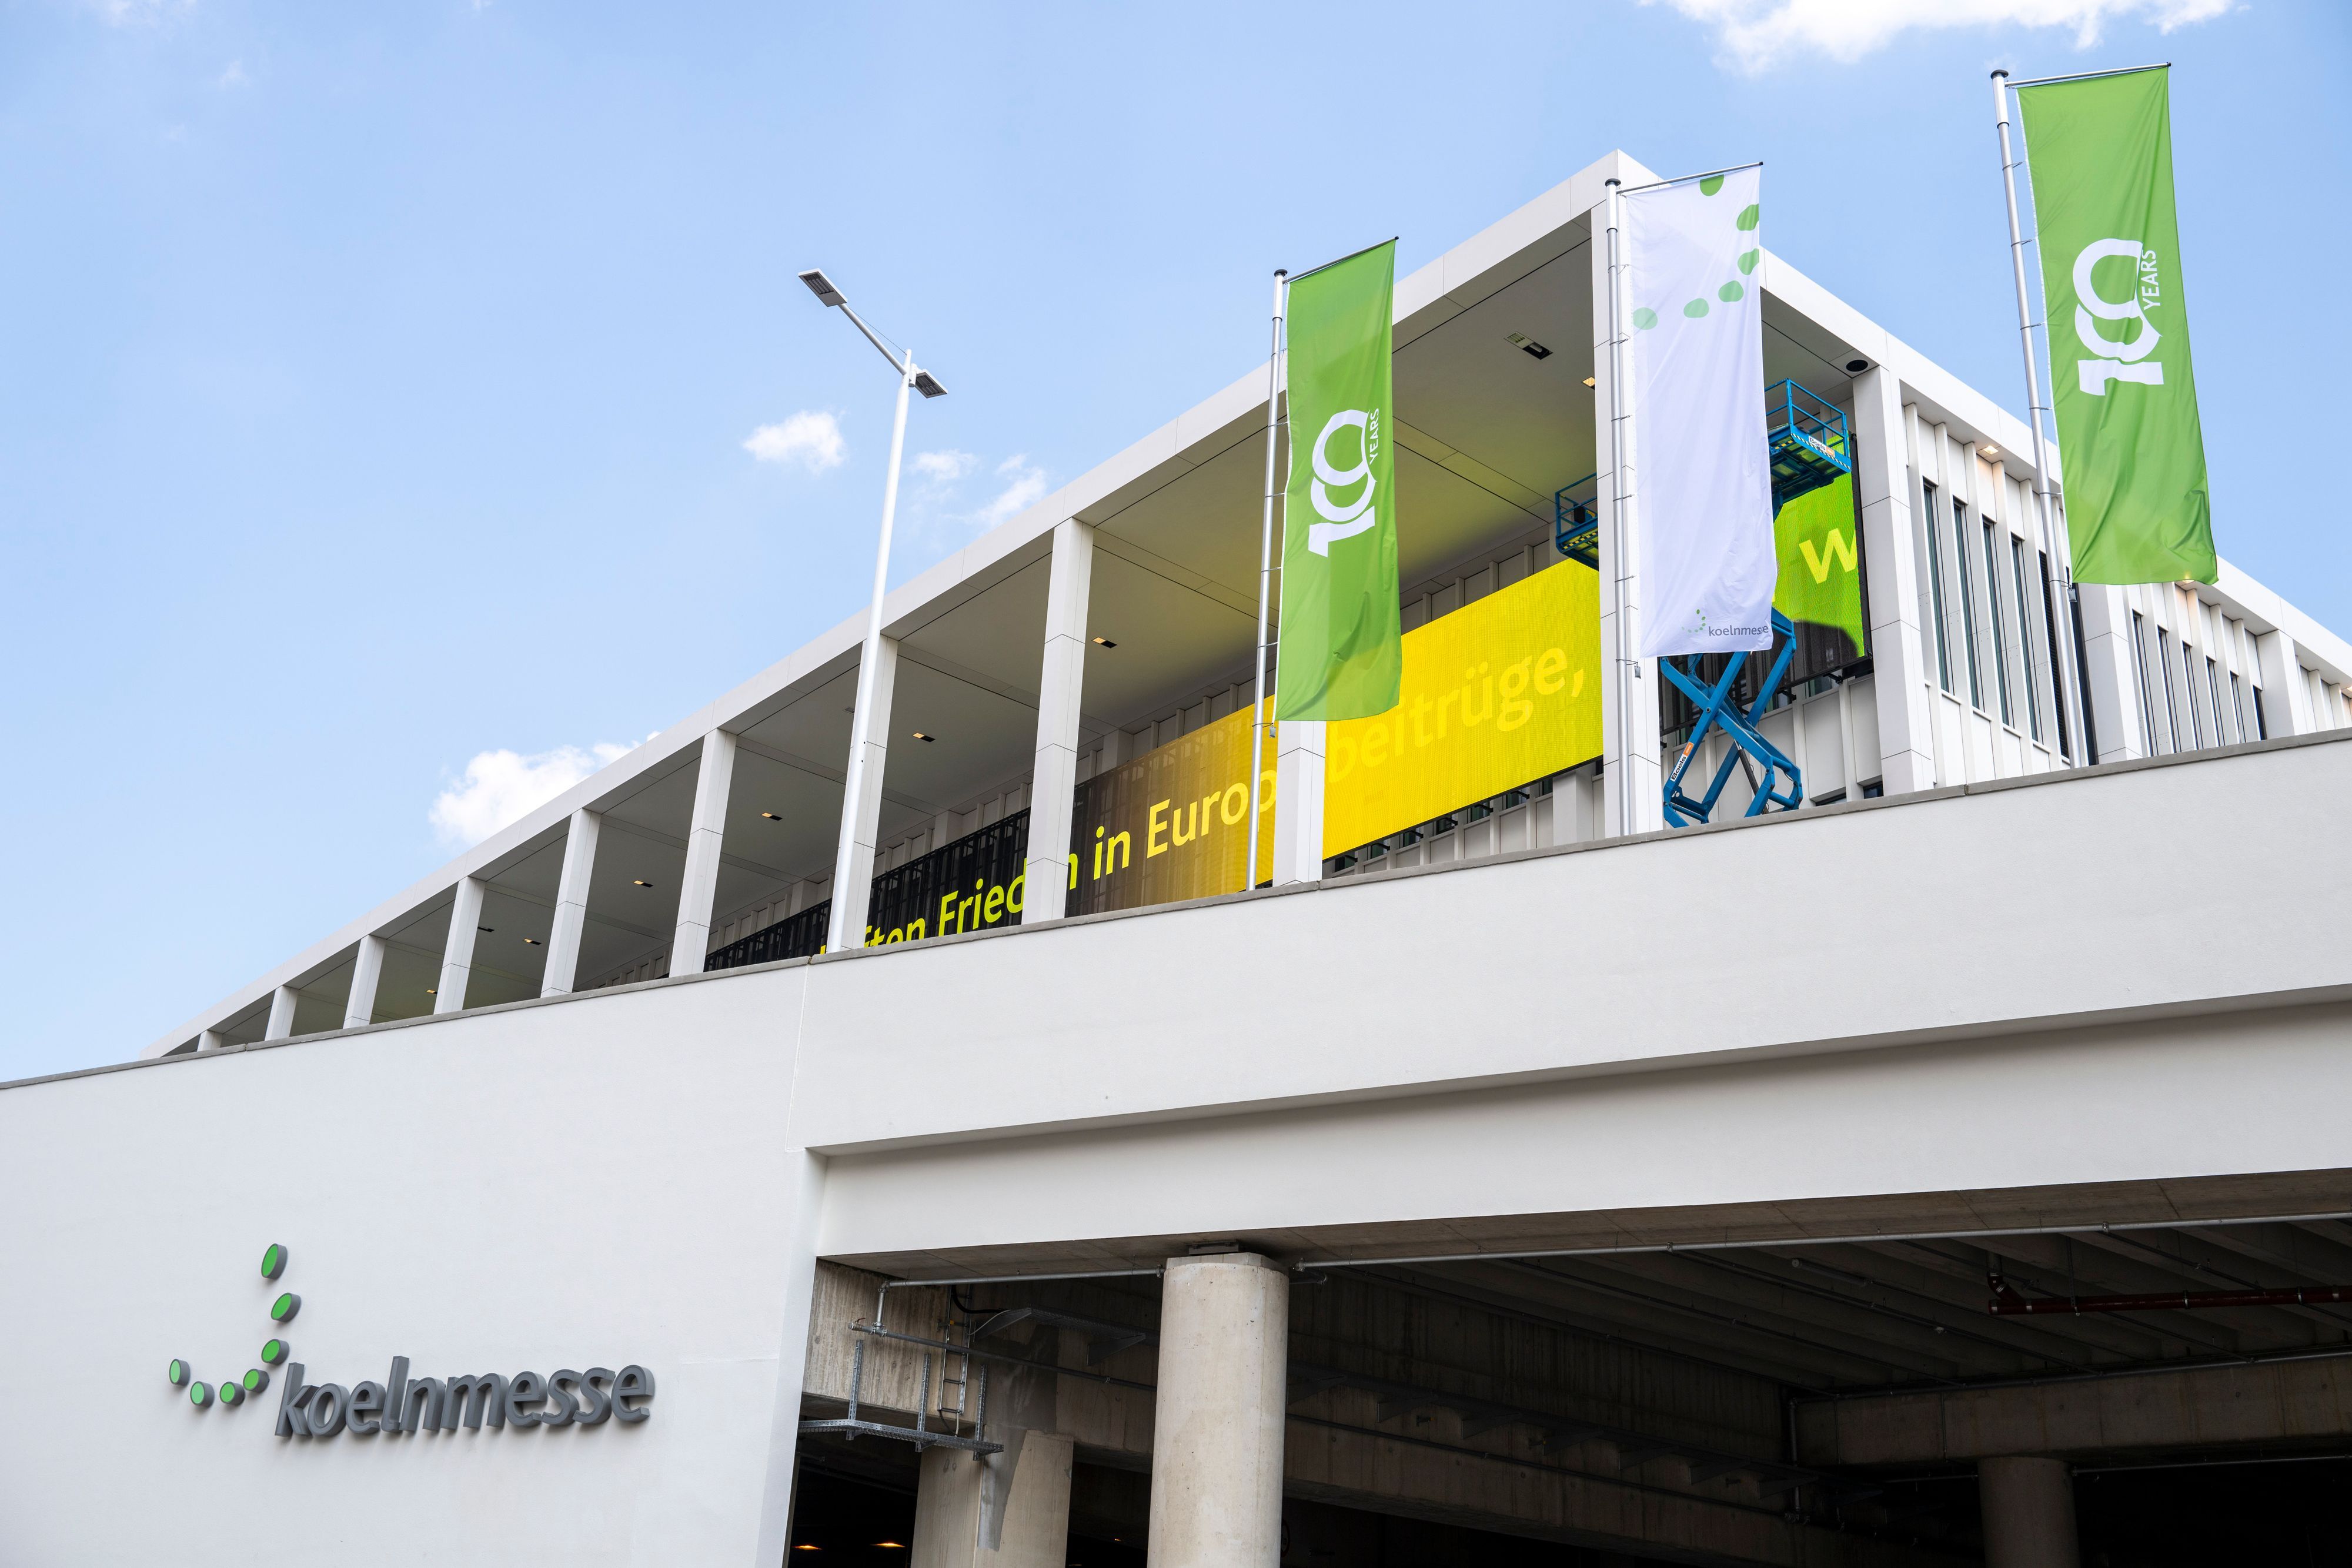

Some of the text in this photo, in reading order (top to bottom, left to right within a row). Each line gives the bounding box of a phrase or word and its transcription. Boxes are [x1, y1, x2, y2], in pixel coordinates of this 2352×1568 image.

[2140, 249, 2161, 310] YEARS
[2073, 238, 2164, 396] 100
[1369, 408, 1379, 466] YEARS
[1809, 437, 1826, 451] Boels
[1308, 409, 1377, 557] 100
[1671, 756, 1686, 780] Boels
[938, 852, 1078, 935] Friedn
[1093, 826, 1130, 881] in
[1147, 769, 1277, 858] Europ
[275, 1356, 654, 1437] koelnmesse
